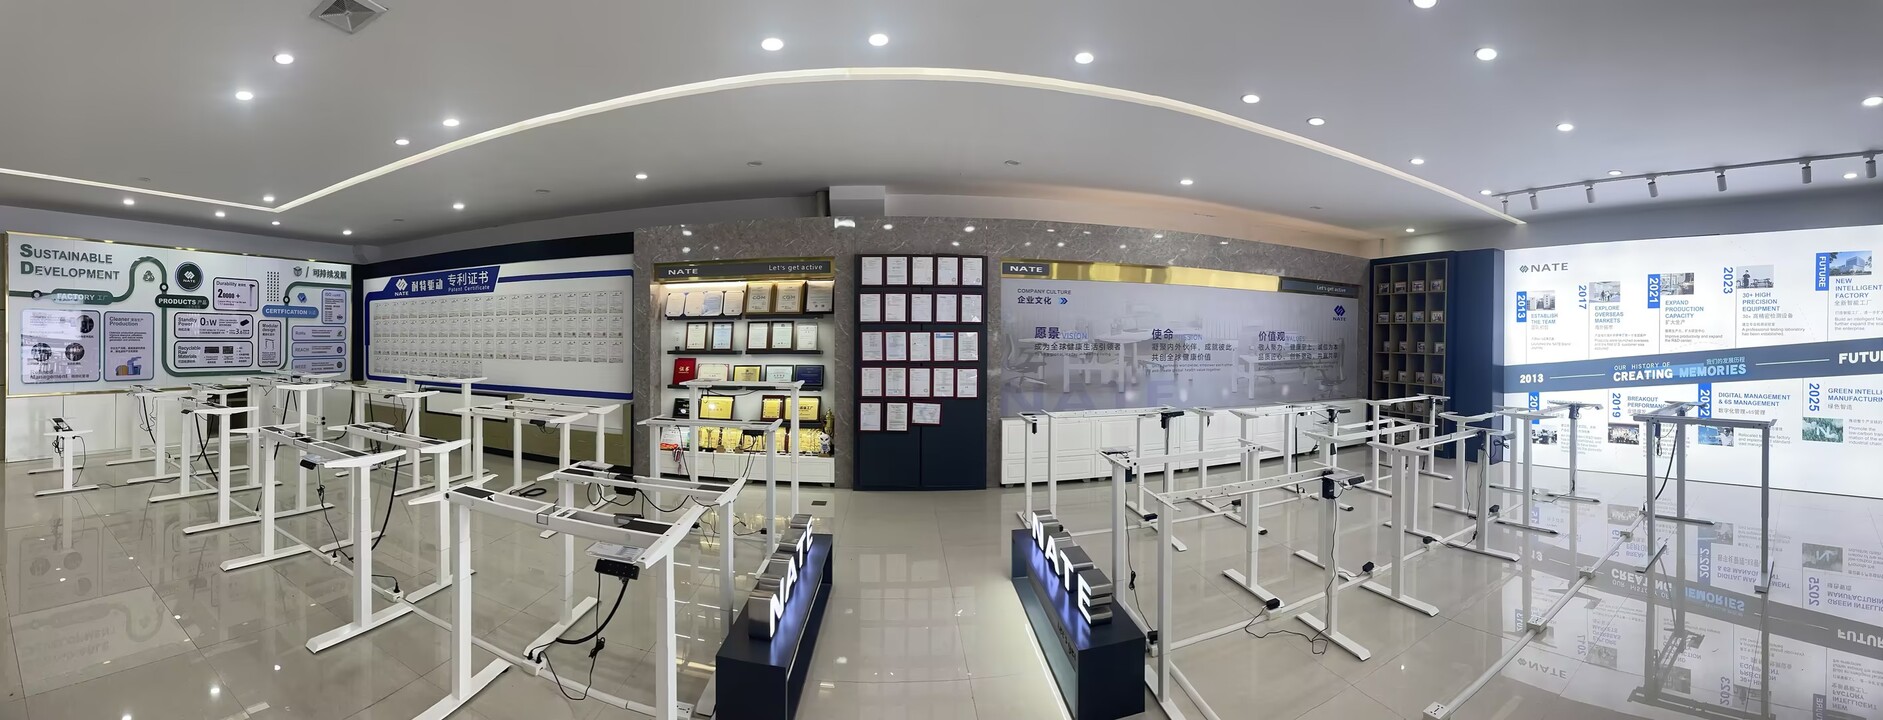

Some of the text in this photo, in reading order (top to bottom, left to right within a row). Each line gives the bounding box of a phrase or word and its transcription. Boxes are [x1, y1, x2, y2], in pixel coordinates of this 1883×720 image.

[20, 244, 112, 264] SUSTAINABLE
[20, 261, 120, 280] DEVELOPMENT
[312, 268, 346, 280] 可持续发展
[1531, 262, 1568, 272] NATE
[1818, 256, 1826, 288] FUTURE
[412, 278, 444, 292] 耐特驱动
[448, 271, 488, 286] 专利证书
[1723, 266, 1734, 294] 2023
[56, 292, 94, 300] FACTORY
[1578, 285, 1587, 310] 2017
[1650, 278, 1659, 304] 2021
[1018, 296, 1052, 304] 企业文化
[1518, 294, 1526, 318] 2013
[1034, 326, 1060, 340] 愿景
[1152, 328, 1174, 340] 使命
[1258, 331, 1286, 342] 价值观
[1034, 342, 1120, 350] 成为全球健康生活引领者
[1152, 354, 1211, 362] 共创全球健康价值
[1706, 356, 1746, 365] 我们的发展历程
[1838, 350, 1883, 364] FUTU
[1520, 374, 1544, 384] 2013
[1613, 364, 1746, 382] CREATING MEMORIES
[1808, 382, 1820, 412] 2025
[1612, 393, 1621, 418] 2019
[1032, 511, 1092, 625] NATE
[770, 516, 813, 638] NATE
